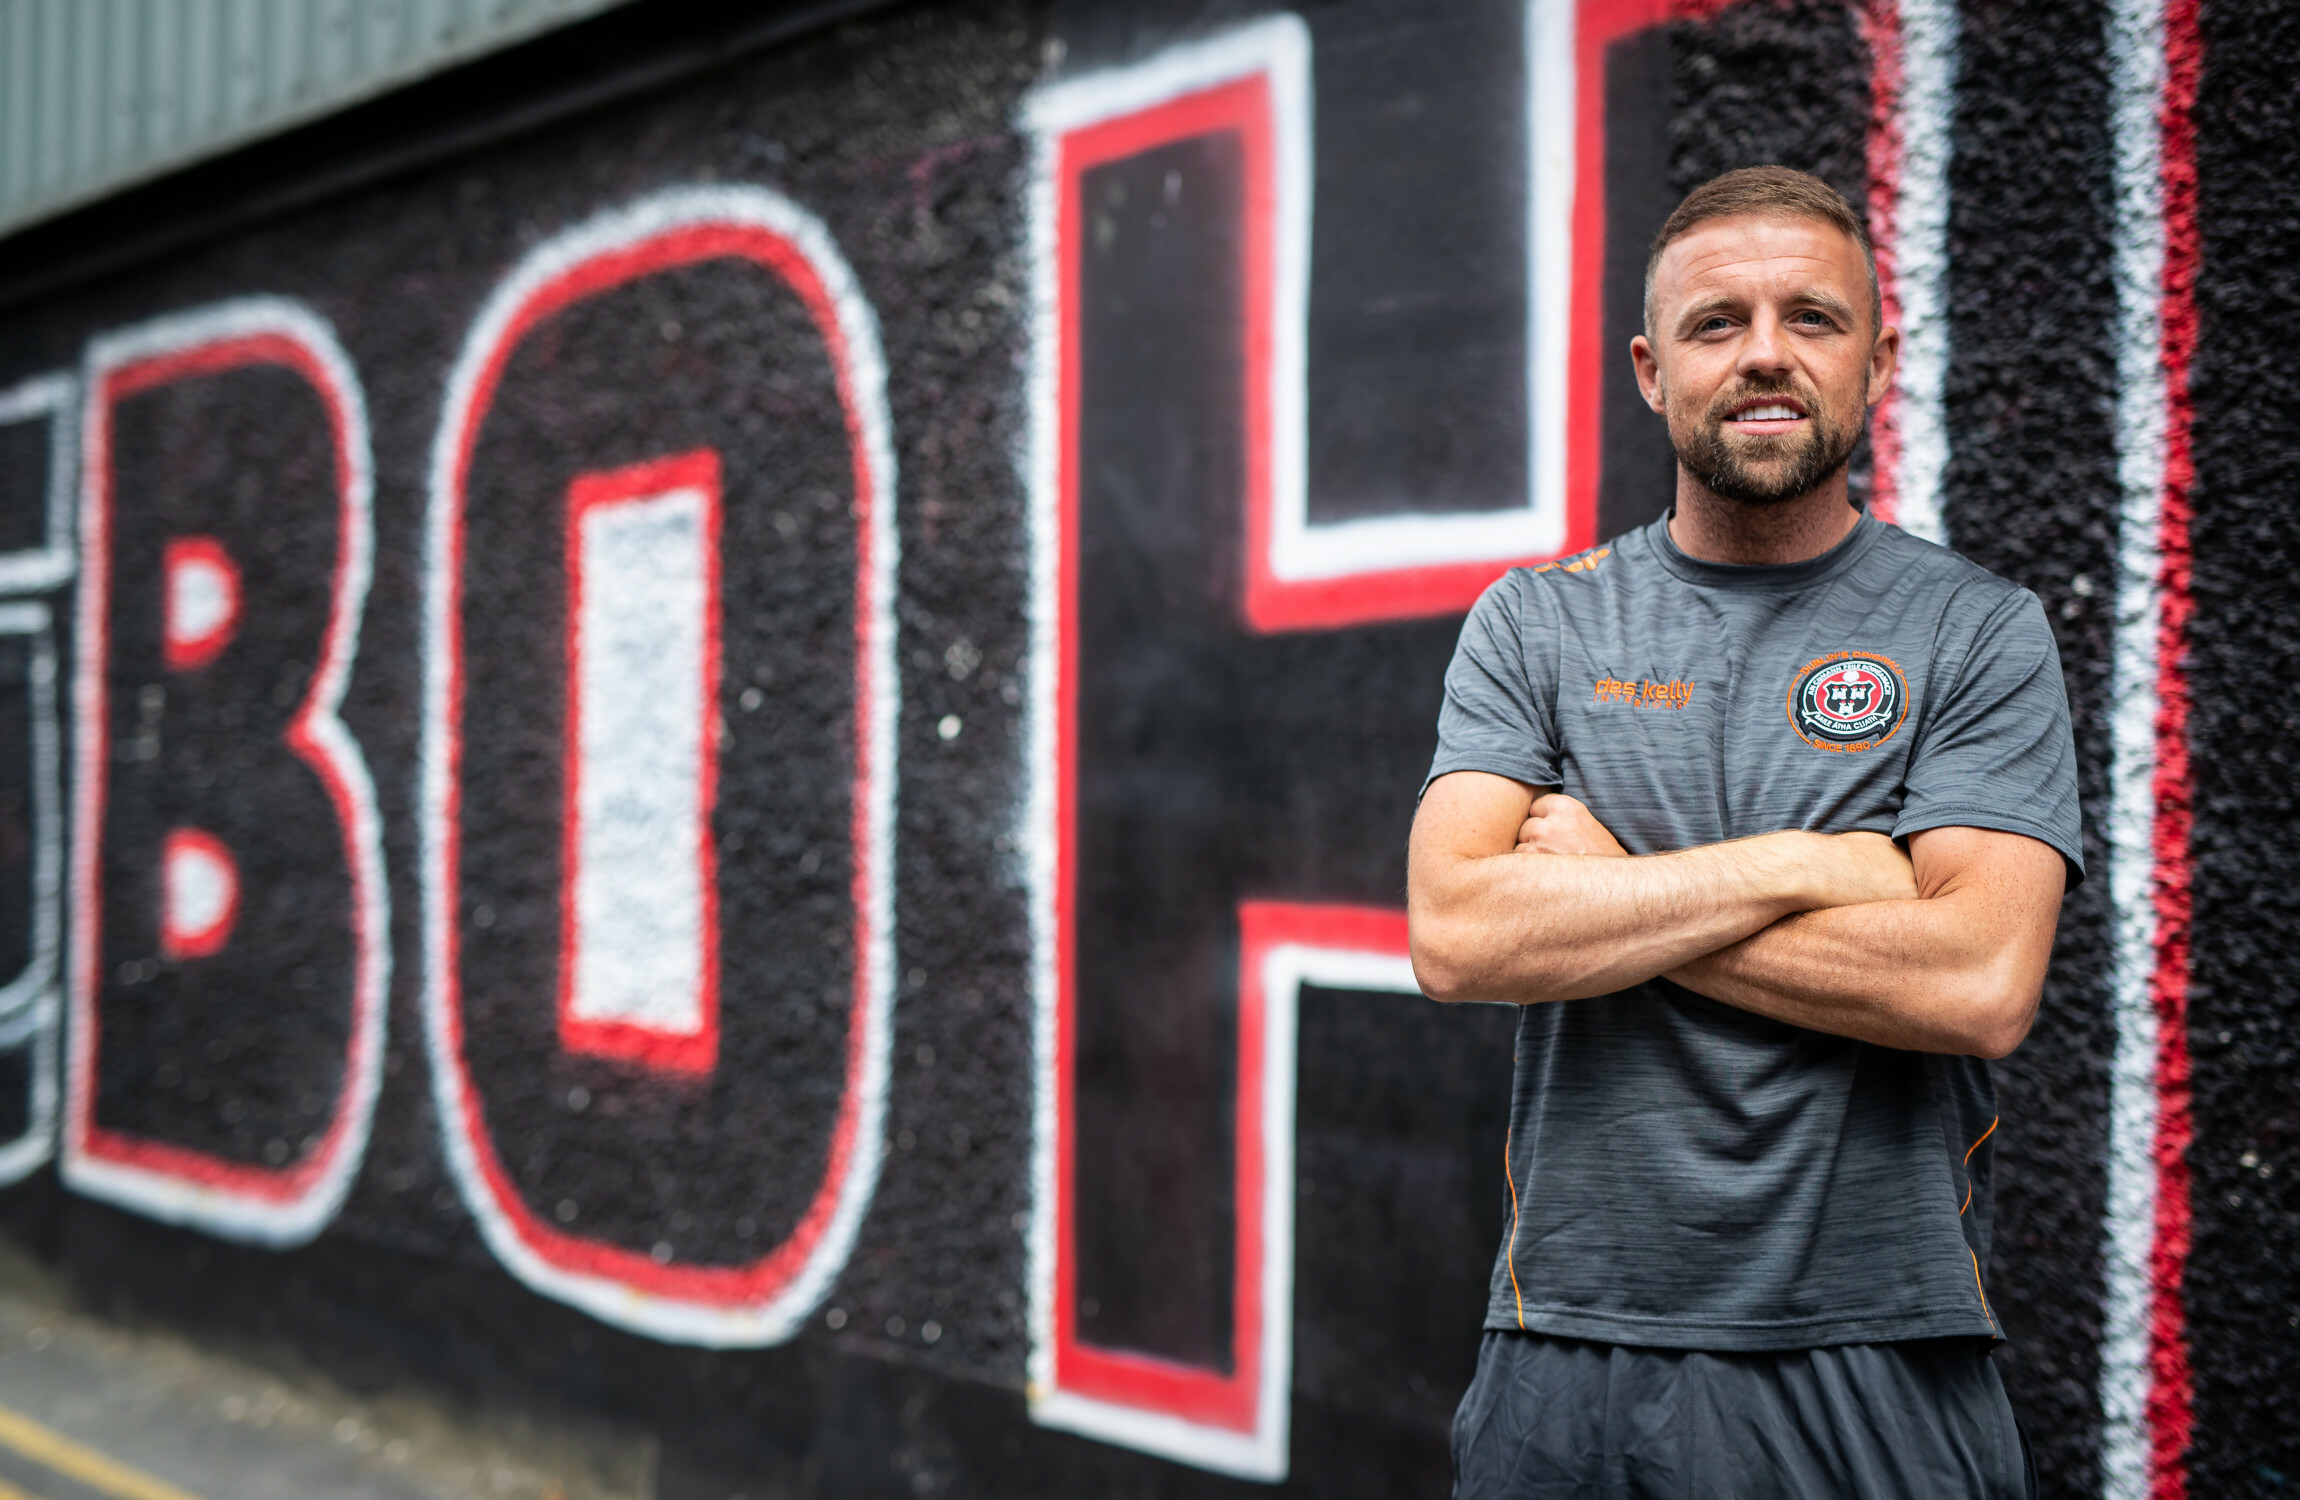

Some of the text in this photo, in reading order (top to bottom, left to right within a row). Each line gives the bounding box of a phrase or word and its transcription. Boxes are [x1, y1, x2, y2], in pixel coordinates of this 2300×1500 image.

[1800, 651, 1905, 676] DUBLIN'S ORIGINALS
[1593, 693, 1682, 709] INTERIORS
[1595, 676, 1695, 706] des kelly
[1814, 713, 1832, 728] BAILE
[1853, 715, 1878, 729] CLIATH
[62, 0, 2300, 1480] BOH
[1812, 738, 1871, 753] SINCE 1890
